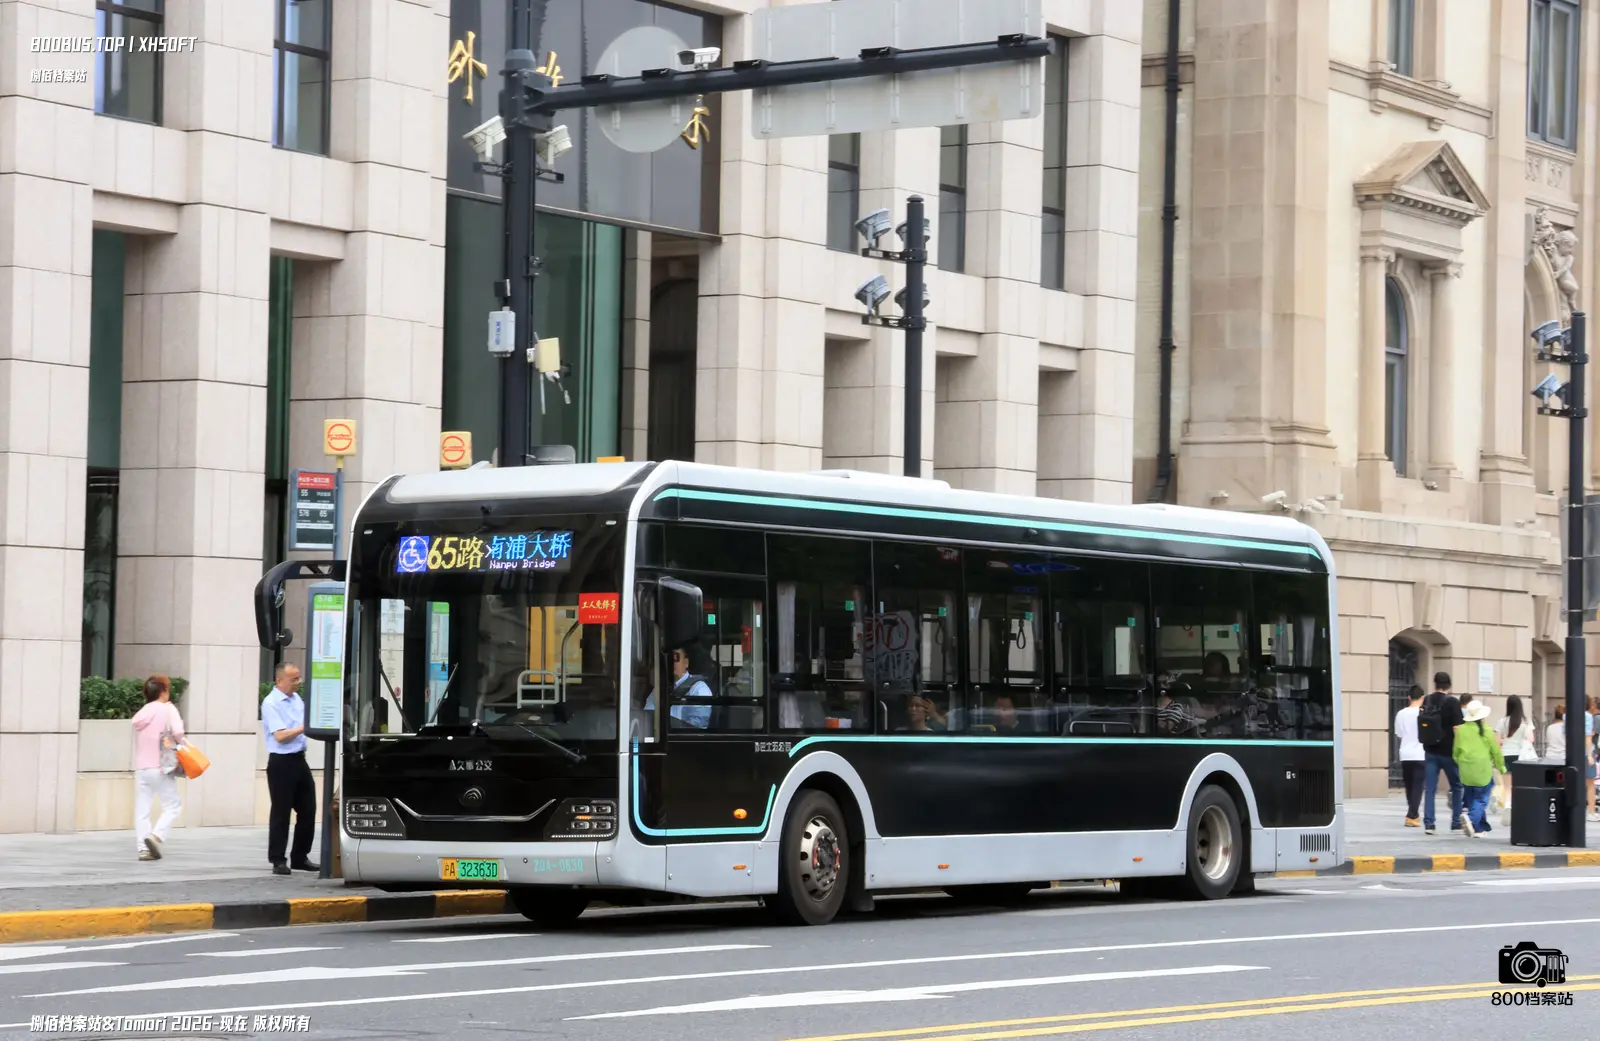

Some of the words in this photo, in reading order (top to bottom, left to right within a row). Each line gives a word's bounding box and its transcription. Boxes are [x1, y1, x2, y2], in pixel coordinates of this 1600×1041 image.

[427, 536, 484, 569] 65路
[489, 559, 518, 569] Nanpu
[522, 559, 556, 569] Bridge
